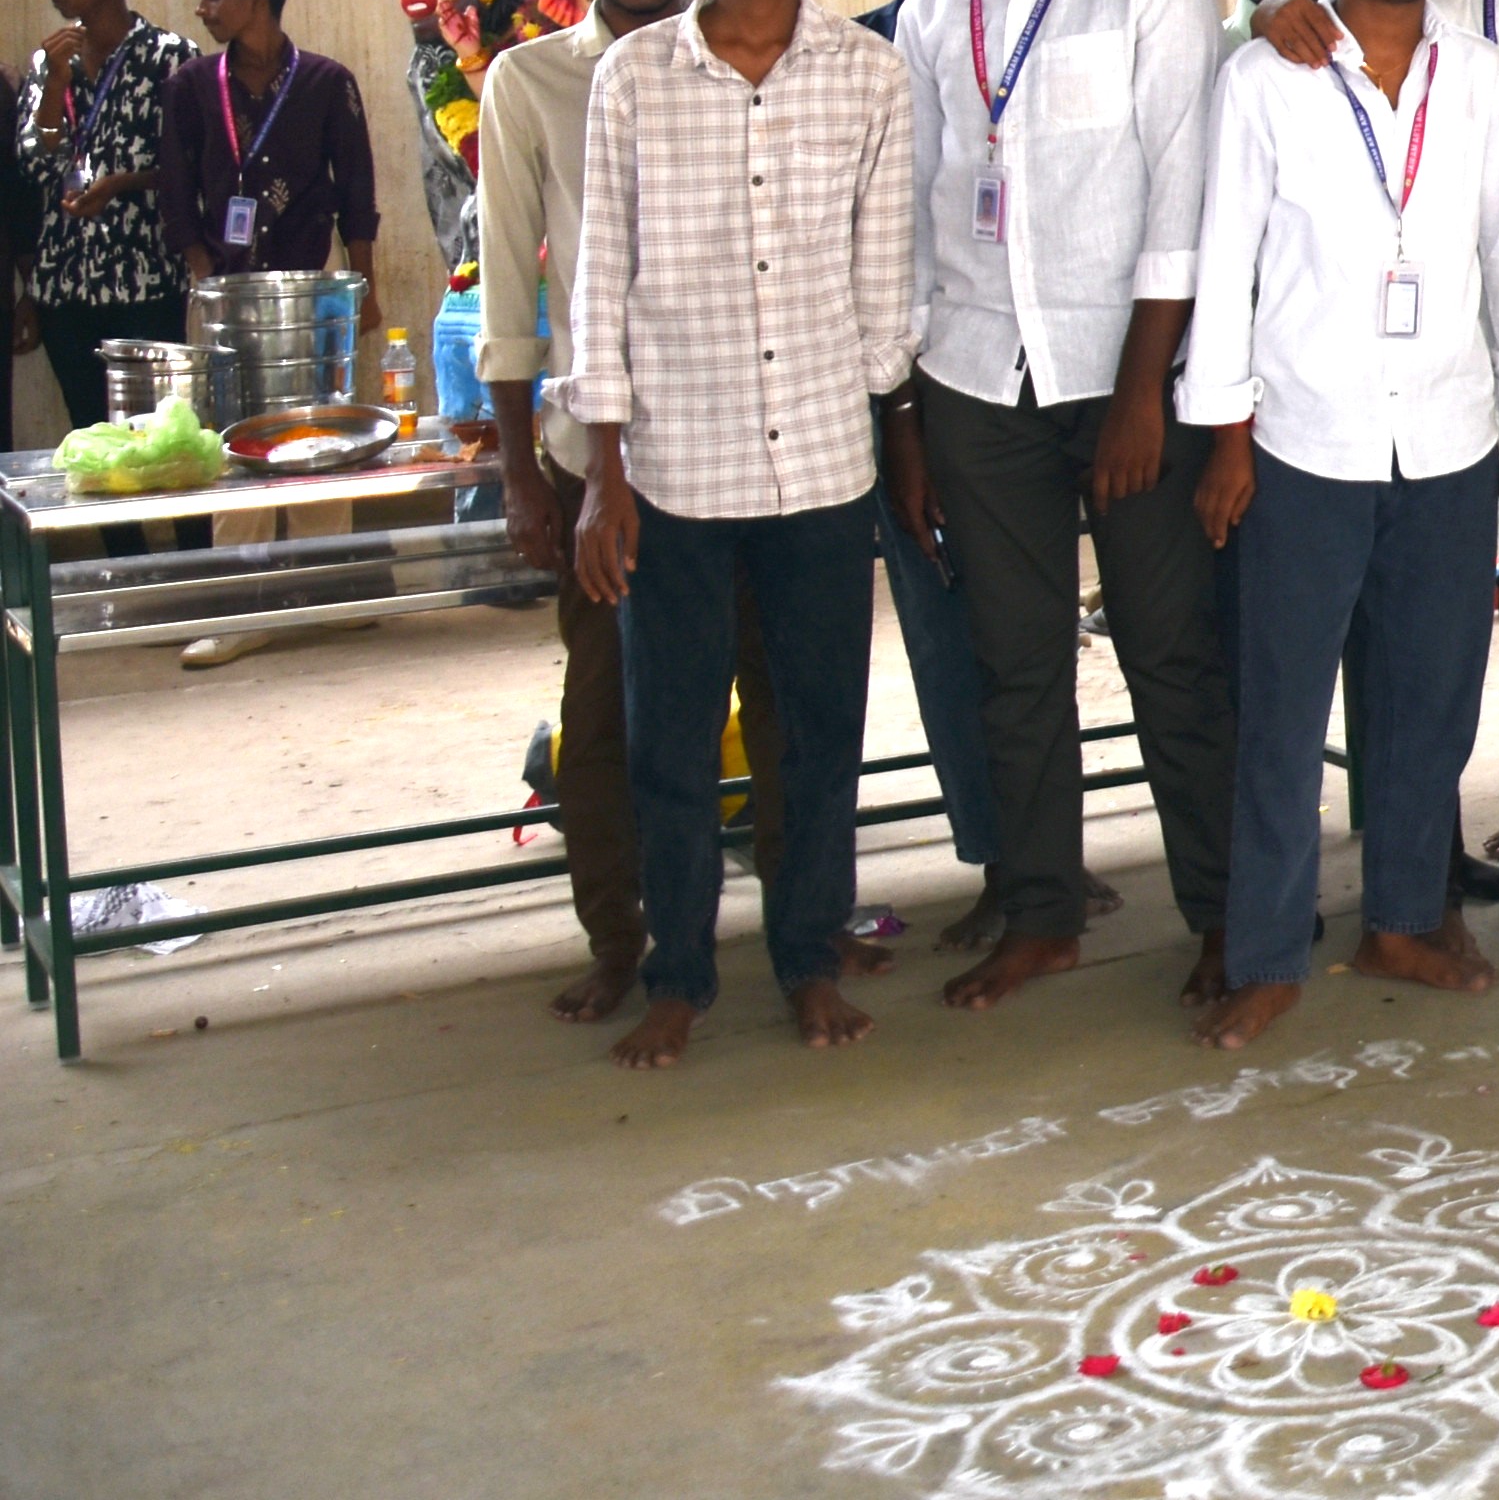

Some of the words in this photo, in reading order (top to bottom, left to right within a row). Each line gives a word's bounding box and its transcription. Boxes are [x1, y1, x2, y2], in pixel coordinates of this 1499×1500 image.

[1001, 54, 1020, 86] JAIRAM
[1014, 34, 1029, 56] ARTS
[1022, 16, 1037, 36] AND
[1354, 107, 1368, 127] AND
[1362, 125, 1377, 148] ARTS
[1411, 122, 1422, 143] ARTS
[1406, 143, 1418, 174] JAIRAM
